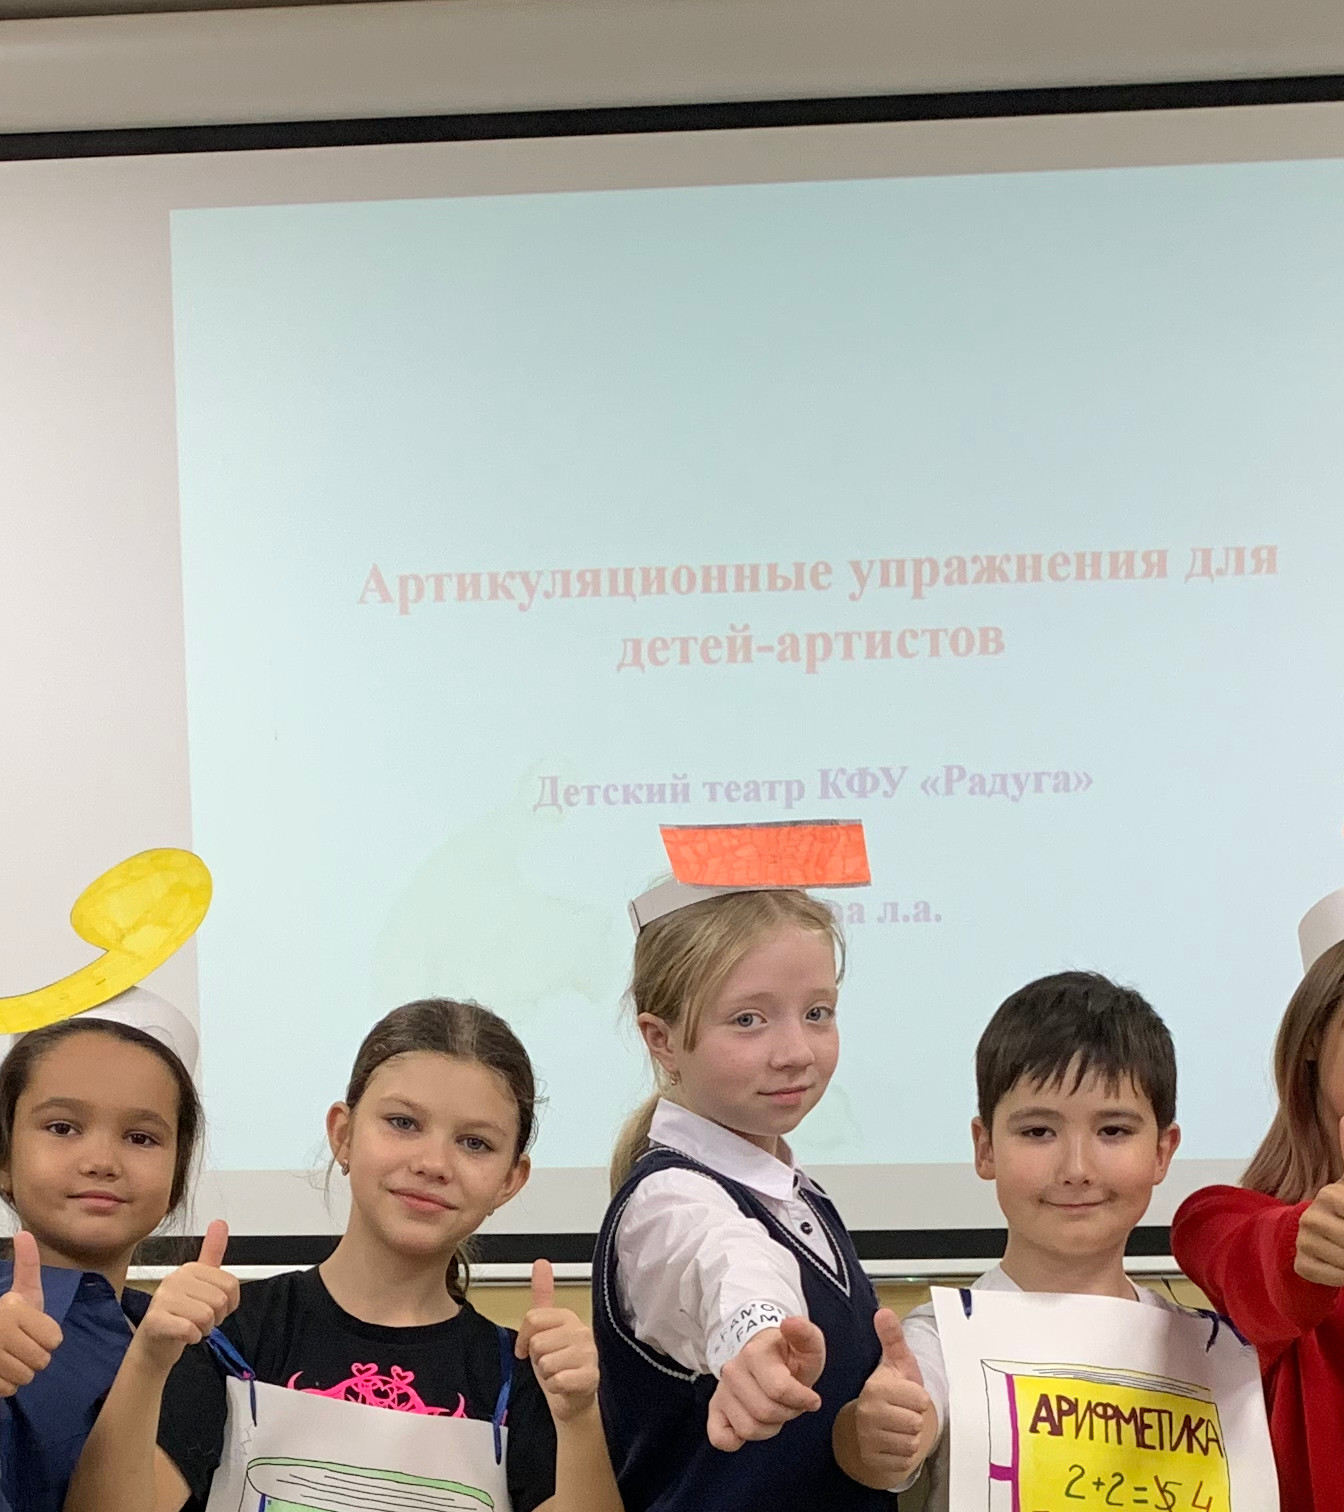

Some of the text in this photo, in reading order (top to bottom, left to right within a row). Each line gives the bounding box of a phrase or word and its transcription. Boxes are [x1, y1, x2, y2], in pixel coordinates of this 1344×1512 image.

[356, 544, 1279, 616] Артикуляционные упражнения для
[616, 623, 1006, 674] детей-артистов
[533, 763, 1094, 814] Детский театр КФУ «Радуга»
[1029, 1393, 1224, 1458] АРИФМЕТИКА
